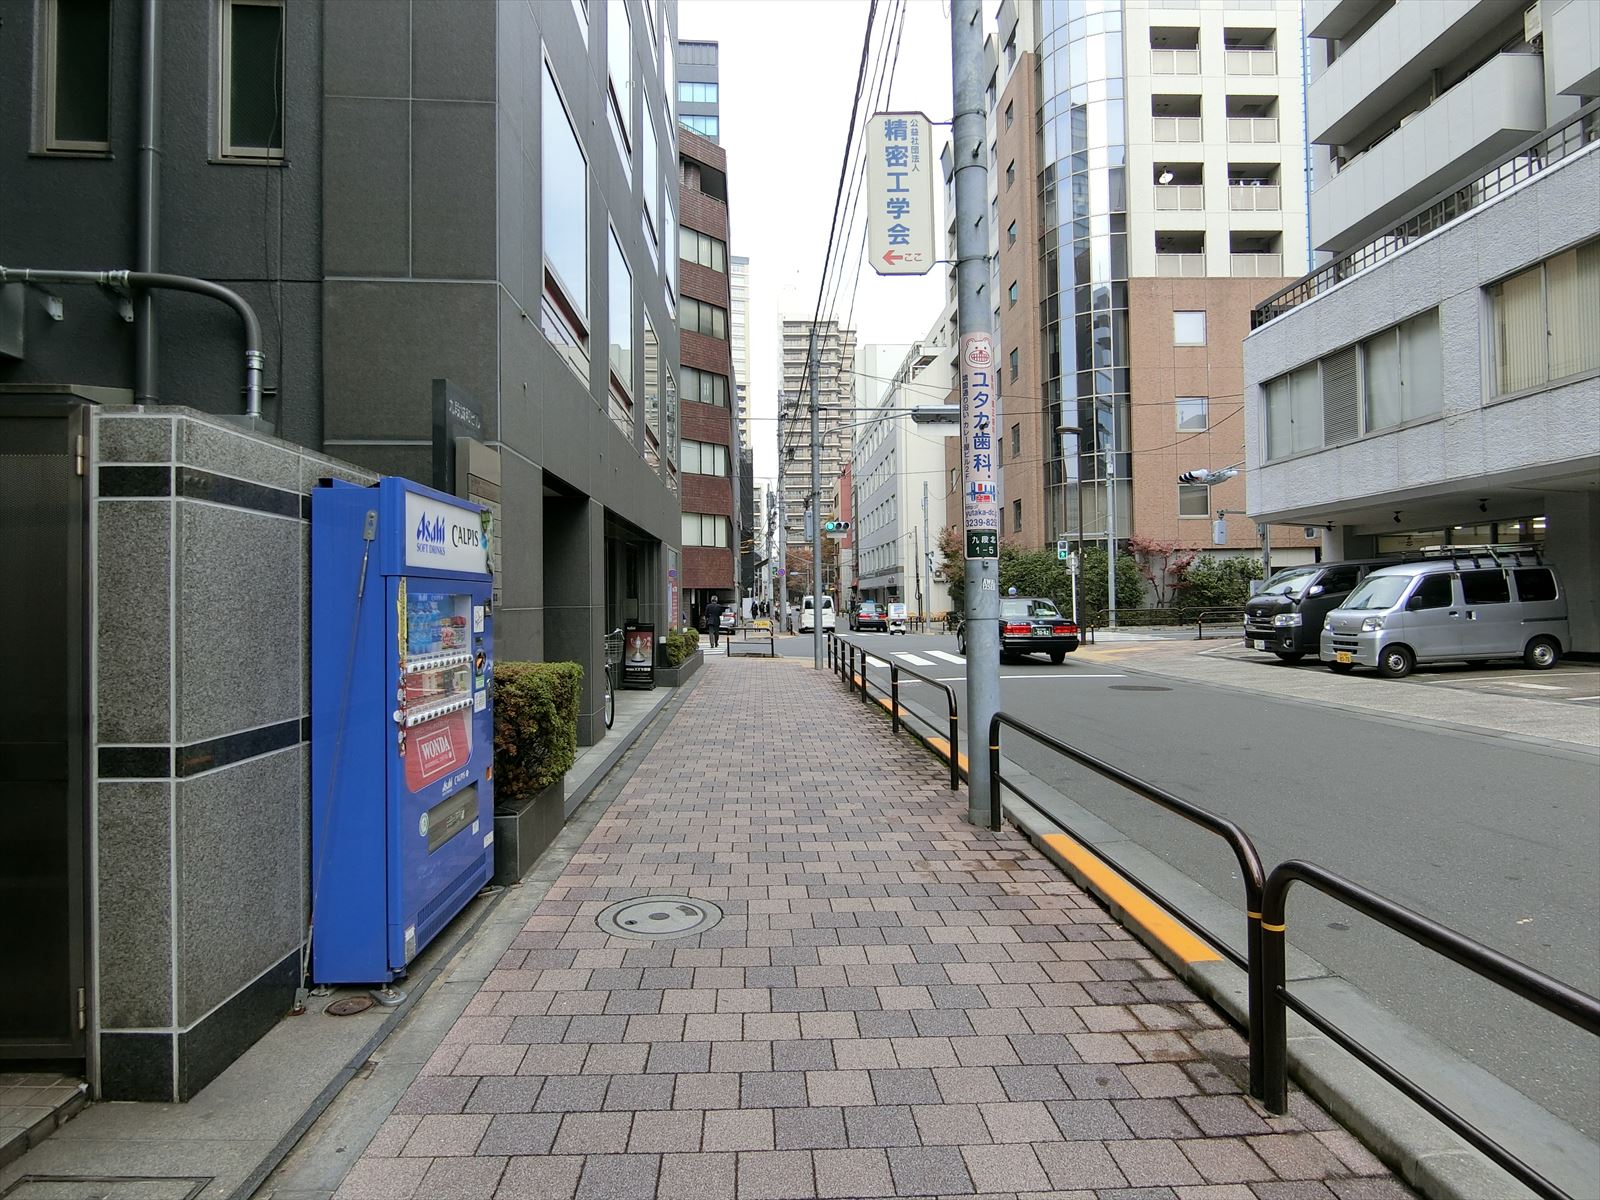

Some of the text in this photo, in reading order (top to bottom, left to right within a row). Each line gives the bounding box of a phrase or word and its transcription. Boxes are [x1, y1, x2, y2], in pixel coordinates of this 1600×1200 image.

[910, 119, 920, 172] 公益社団法人
[884, 118, 910, 246] 精密工学会
[904, 252, 923, 262] ここ
[972, 372, 992, 472] ユタカ歯科
[416, 511, 479, 548] Asahi CALPIS
[971, 535, 997, 544] 九段北
[416, 542, 446, 556] SOFT DRINKS
[975, 546, 994, 555] 1-5
[421, 735, 451, 761] WONDA
